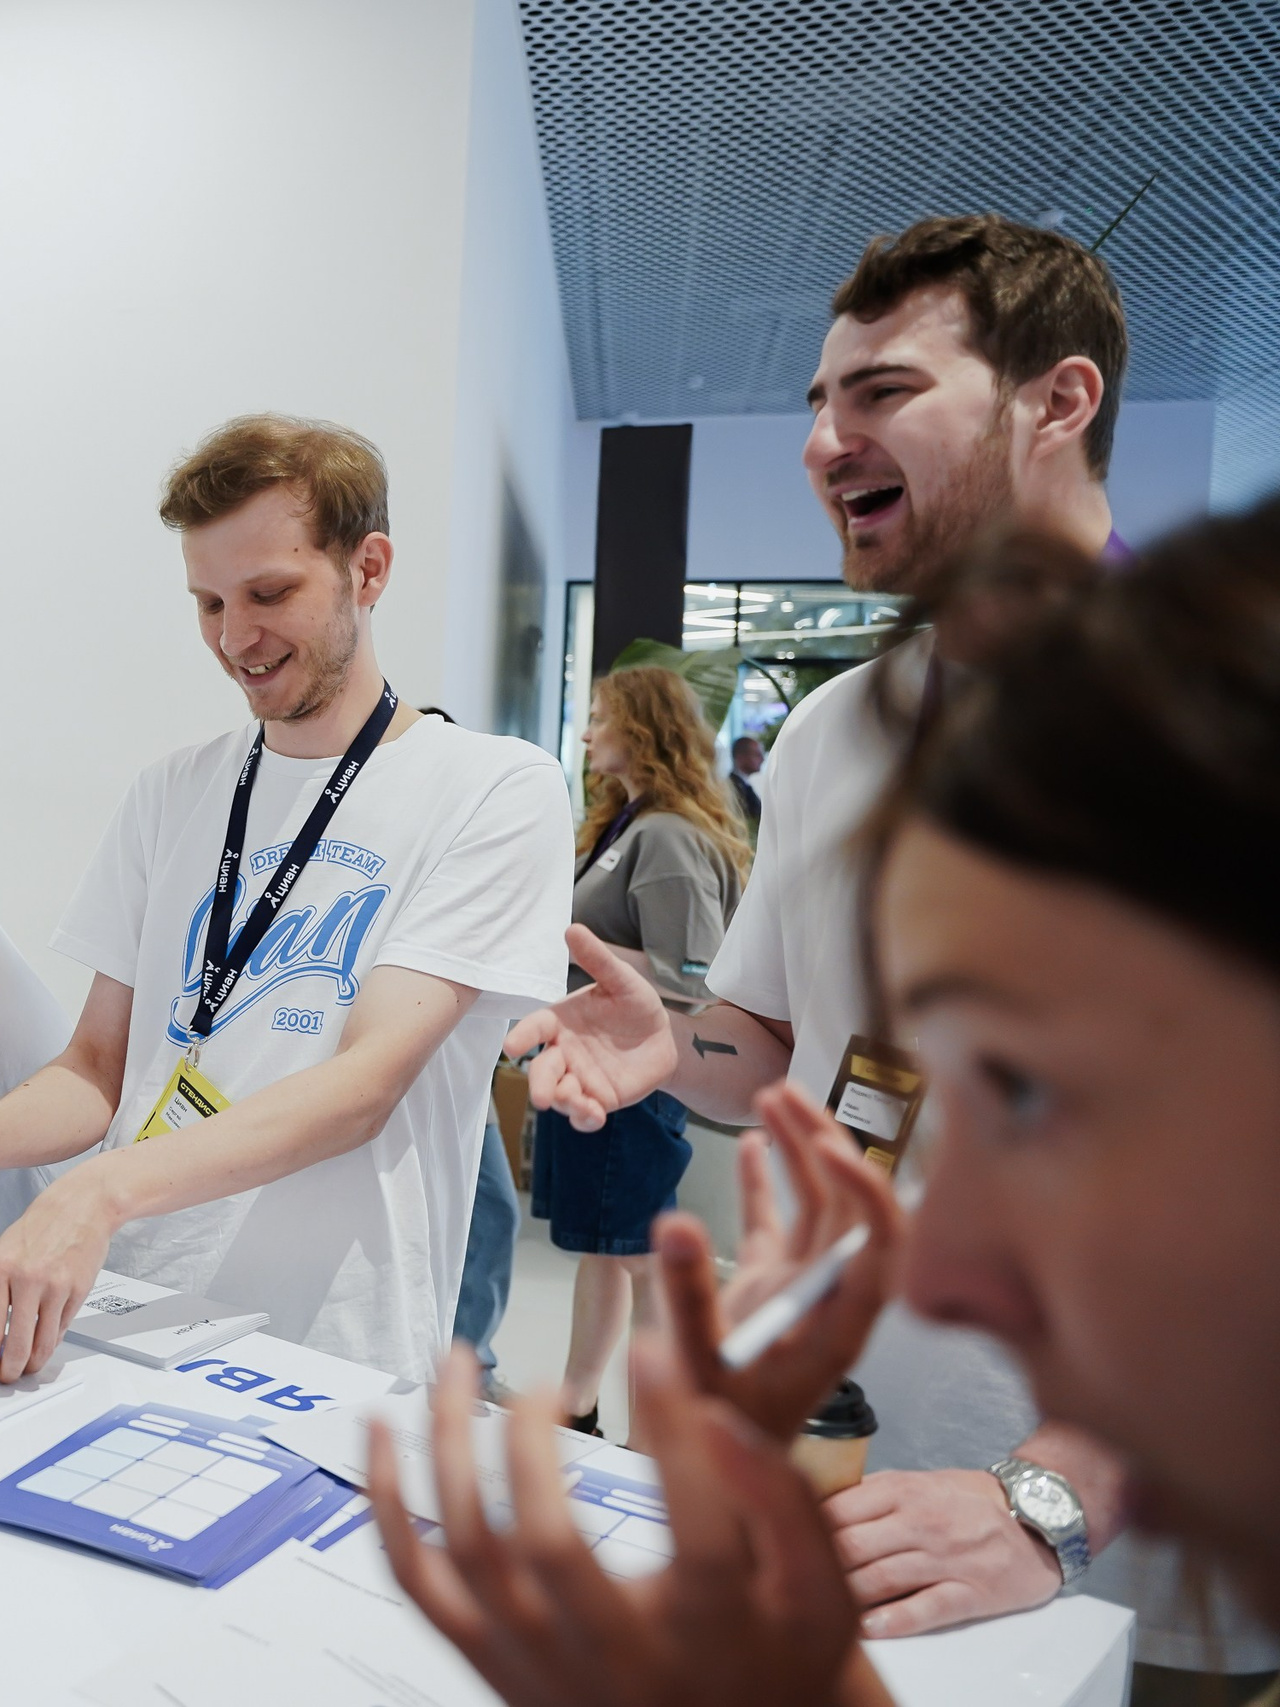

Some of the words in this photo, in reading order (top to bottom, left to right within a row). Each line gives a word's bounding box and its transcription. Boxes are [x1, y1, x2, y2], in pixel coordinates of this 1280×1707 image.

[335, 761, 360, 792] циан
[332, 845, 380, 874] TEAM
[218, 861, 231, 893] циан
[274, 863, 300, 896] циан
[215, 969, 238, 1001] циан
[276, 1012, 320, 1030] 2001
[174, 1097, 187, 1113] Циан
